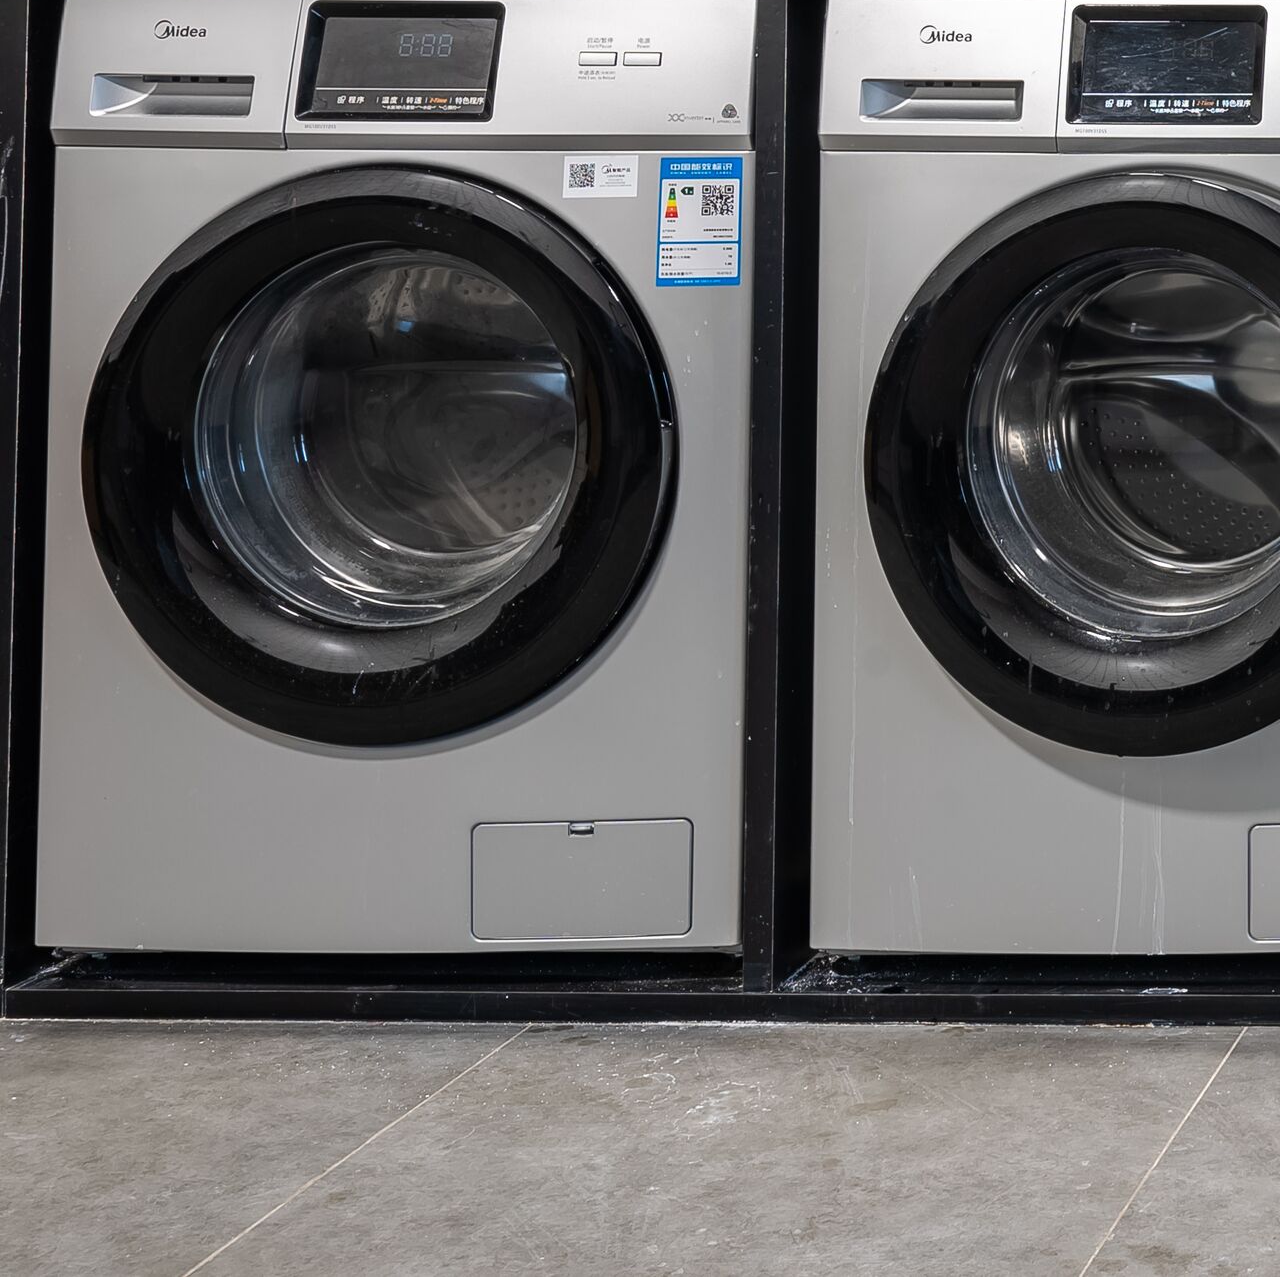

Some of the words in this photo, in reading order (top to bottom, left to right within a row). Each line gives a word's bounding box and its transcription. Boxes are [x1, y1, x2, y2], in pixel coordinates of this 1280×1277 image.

[154, 20, 207, 39] Midea
[920, 25, 972, 44] Midea
[349, 96, 364, 104] 程序
[382, 96, 398, 104] 温度
[455, 97, 485, 105] 特色程序
[1117, 100, 1132, 108] 程序
[1150, 100, 1165, 108] 温度
[1222, 99, 1251, 108] 特色程序
[670, 163, 733, 171] 中国能效标识
